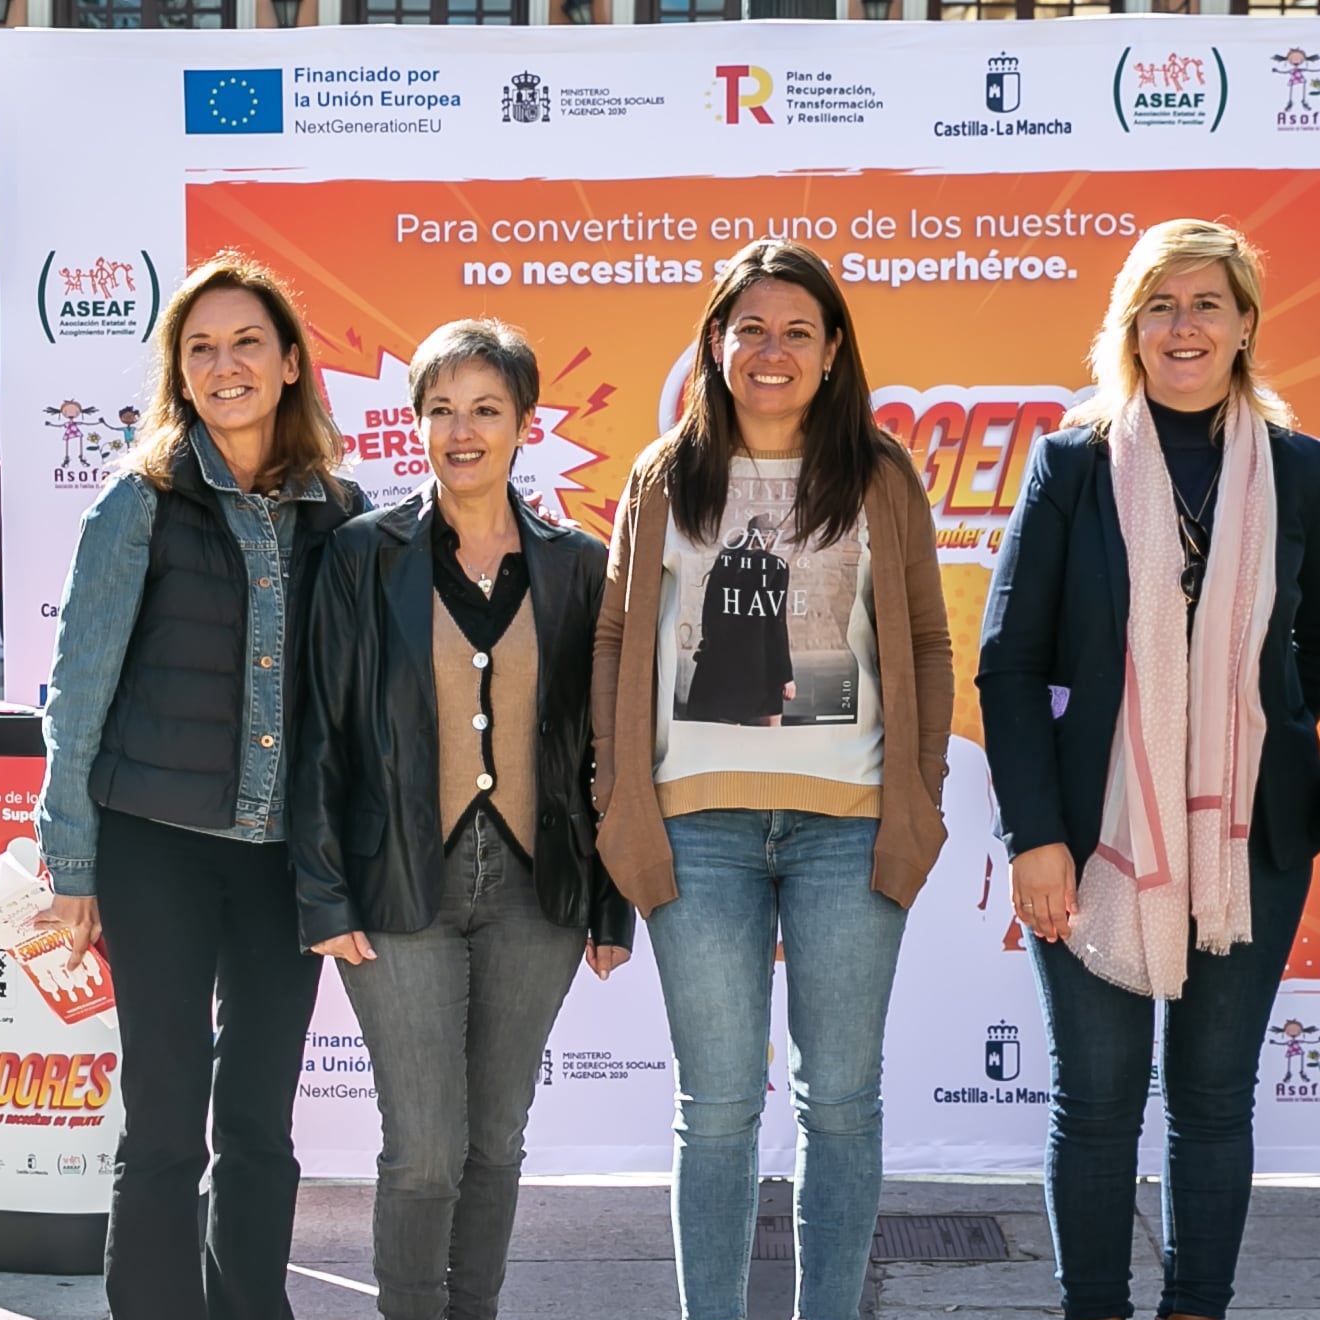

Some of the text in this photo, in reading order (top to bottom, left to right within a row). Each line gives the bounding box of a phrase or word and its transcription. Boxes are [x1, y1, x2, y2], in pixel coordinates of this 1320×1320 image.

[294, 67, 440, 86] Financiado por
[787, 71, 832, 81] Plan de
[561, 88, 610, 96] MINISTERIO
[787, 84, 876, 98] Recuperación,
[294, 91, 461, 111] la Unión Europea
[561, 96, 664, 106] DE DERECHOS SOCIALES
[787, 98, 883, 109] Transformación
[1134, 93, 1205, 108] ASEAF
[567, 107, 605, 116] AGENDA
[608, 107, 627, 116] 2030
[787, 112, 864, 125] y Resiliencia
[294, 119, 442, 134] NextGenerationEU
[396, 207, 1144, 243] Para convertirte en uno de los nuestros,
[463, 261, 511, 285] no
[523, 253, 703, 285] necesitas
[841, 249, 1078, 288] Superhéroe.
[60, 301, 135, 317] ASEAF
[366, 406, 415, 428] BUS
[383, 486, 413, 497] niños
[721, 527, 791, 551] ONL
[721, 555, 811, 570] THING
[762, 574, 767, 588] I
[722, 587, 808, 617] HAVE
[5, 791, 22, 804] de
[26, 791, 40, 805] lo
[2, 807, 36, 823] Supe
[563, 1052, 611, 1060] MINISTERIO
[563, 1061, 666, 1070] DE DERECHOS SOCIALES
[568, 1071, 607, 1079] AGENDA
[610, 1071, 628, 1079] 2030
[300, 1084, 377, 1098] NextGene
